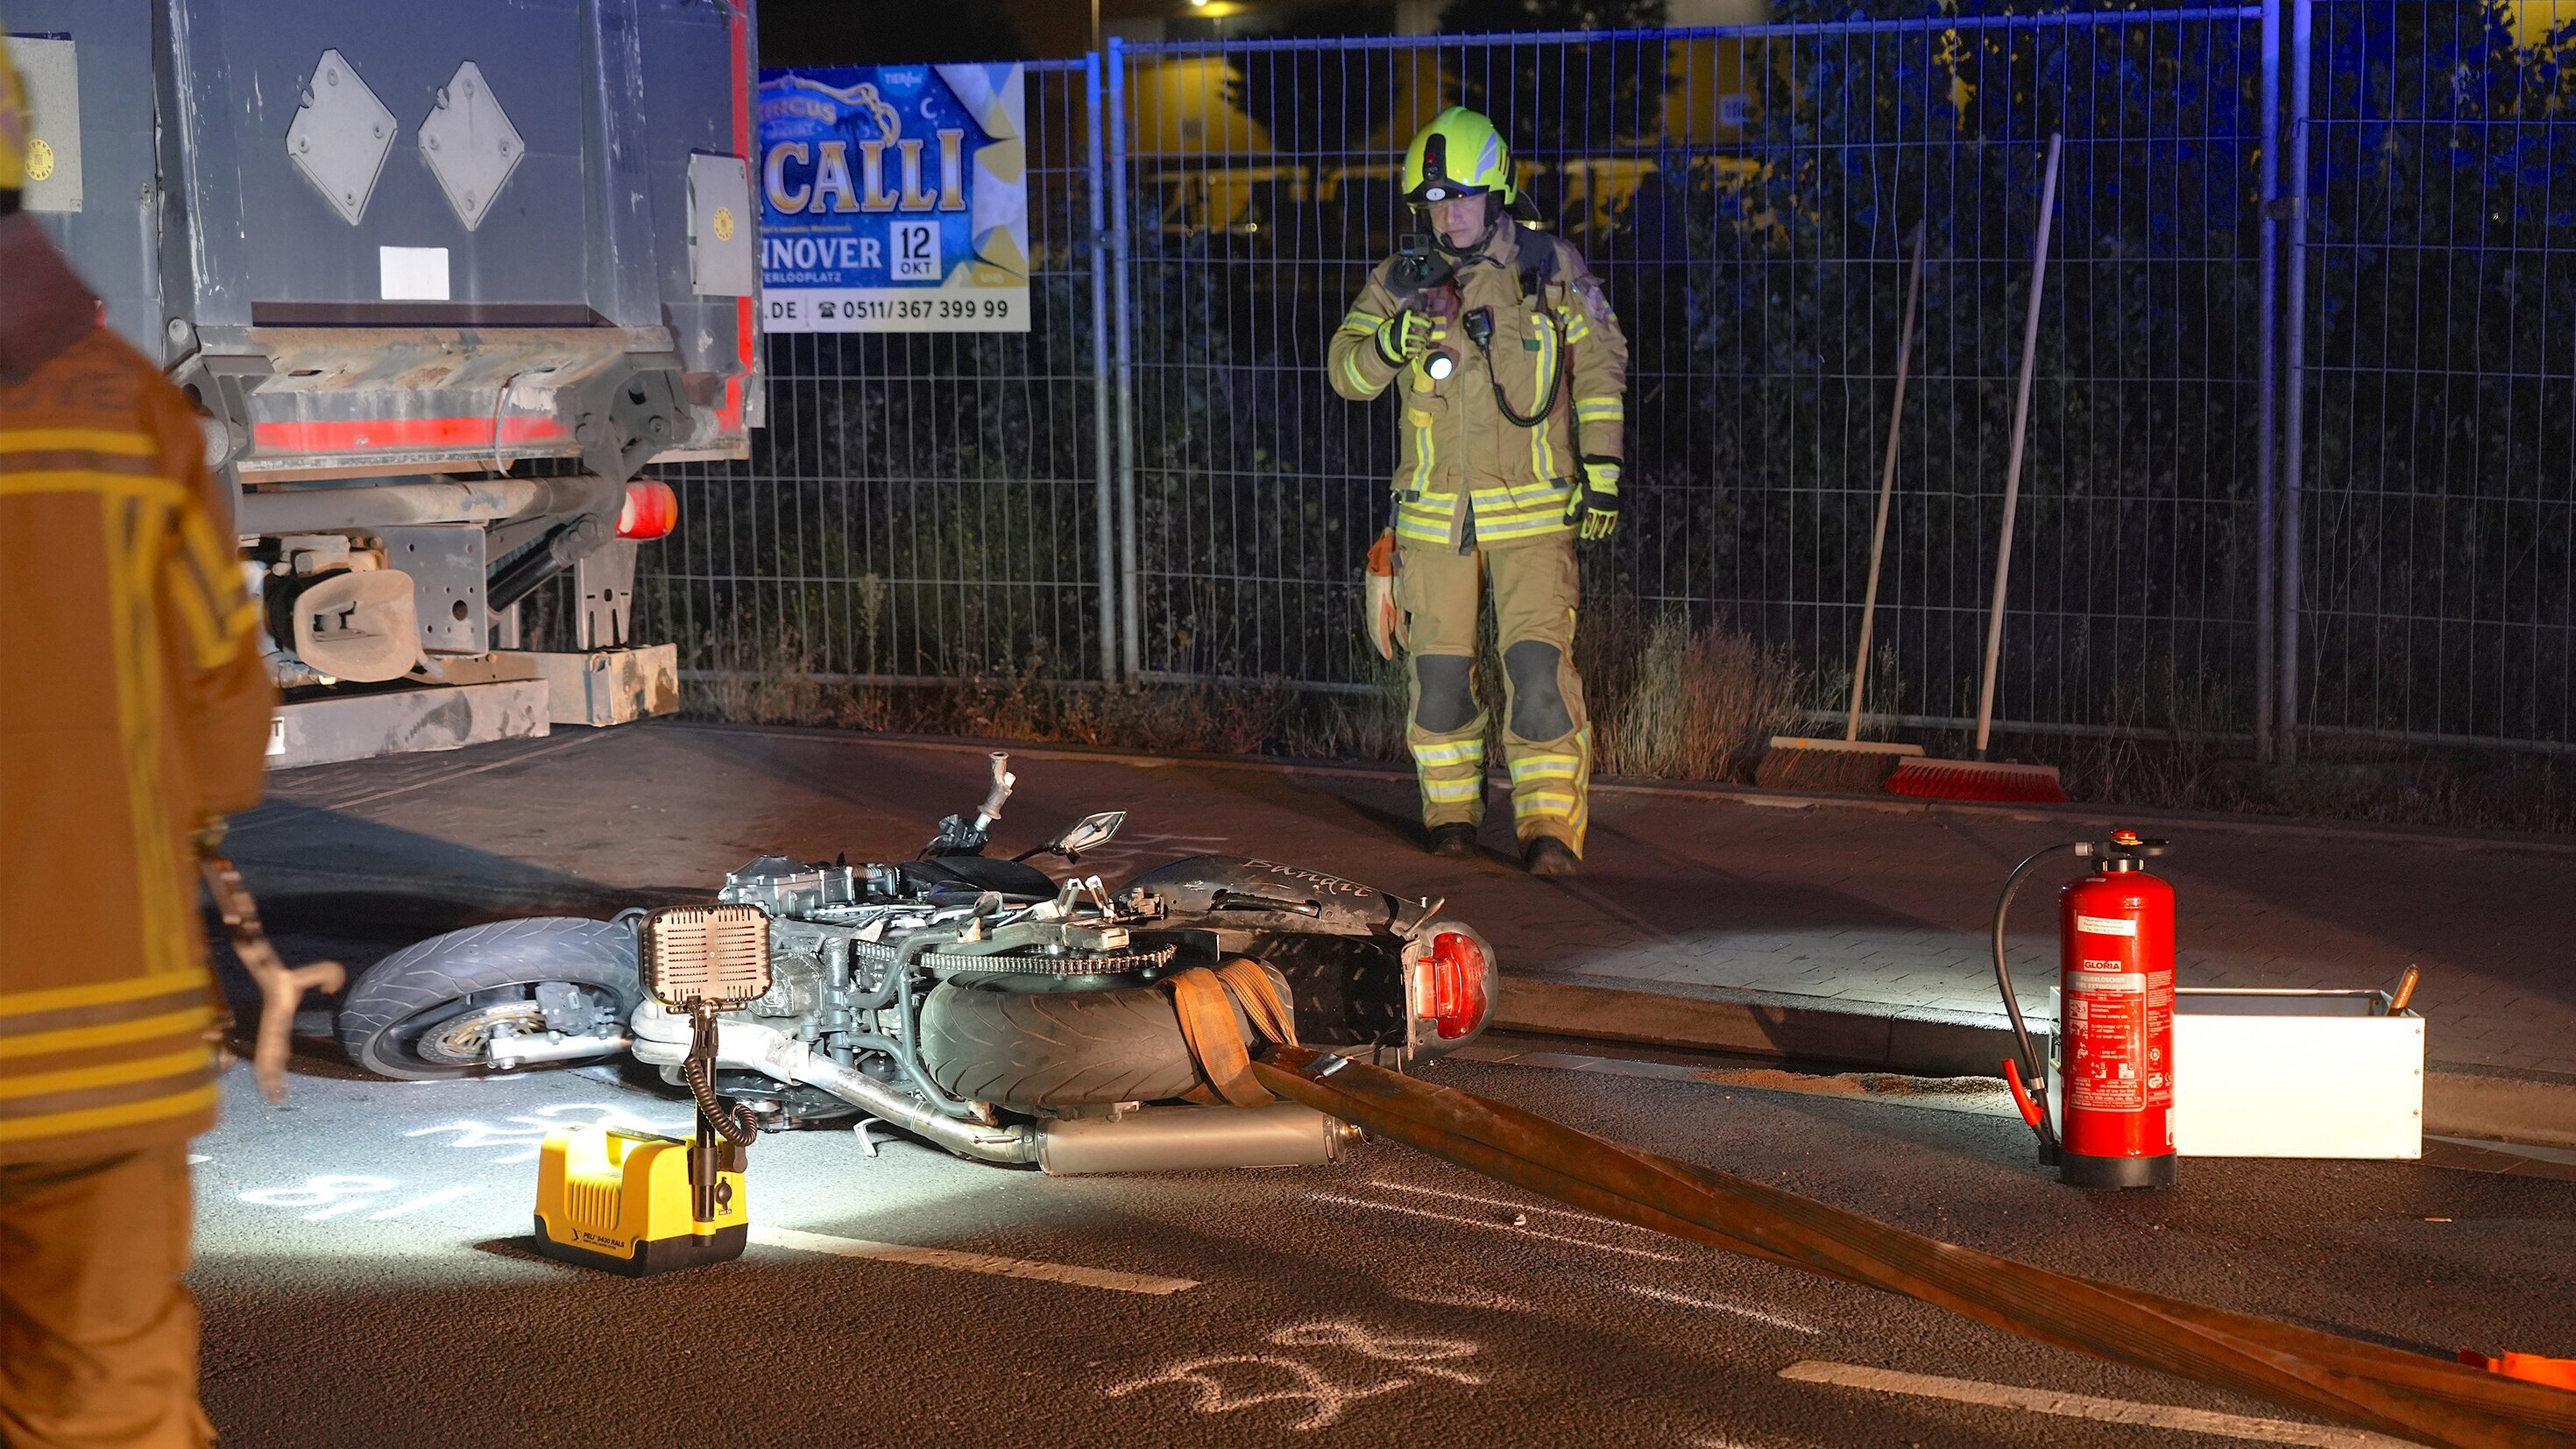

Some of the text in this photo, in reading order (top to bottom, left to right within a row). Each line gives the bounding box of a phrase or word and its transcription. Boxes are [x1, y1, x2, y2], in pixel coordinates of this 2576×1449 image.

[759, 128, 966, 215] CALLI
[902, 227, 931, 258] 12
[761, 271, 842, 283] ERLOOPLATZ
[901, 262, 931, 275] OKT
[843, 300, 933, 319] 0511/367
[938, 300, 977, 319] 399
[984, 300, 1008, 319] 99
[1238, 859, 1373, 897] Bandit
[2084, 961, 2120, 970] GLORIA
